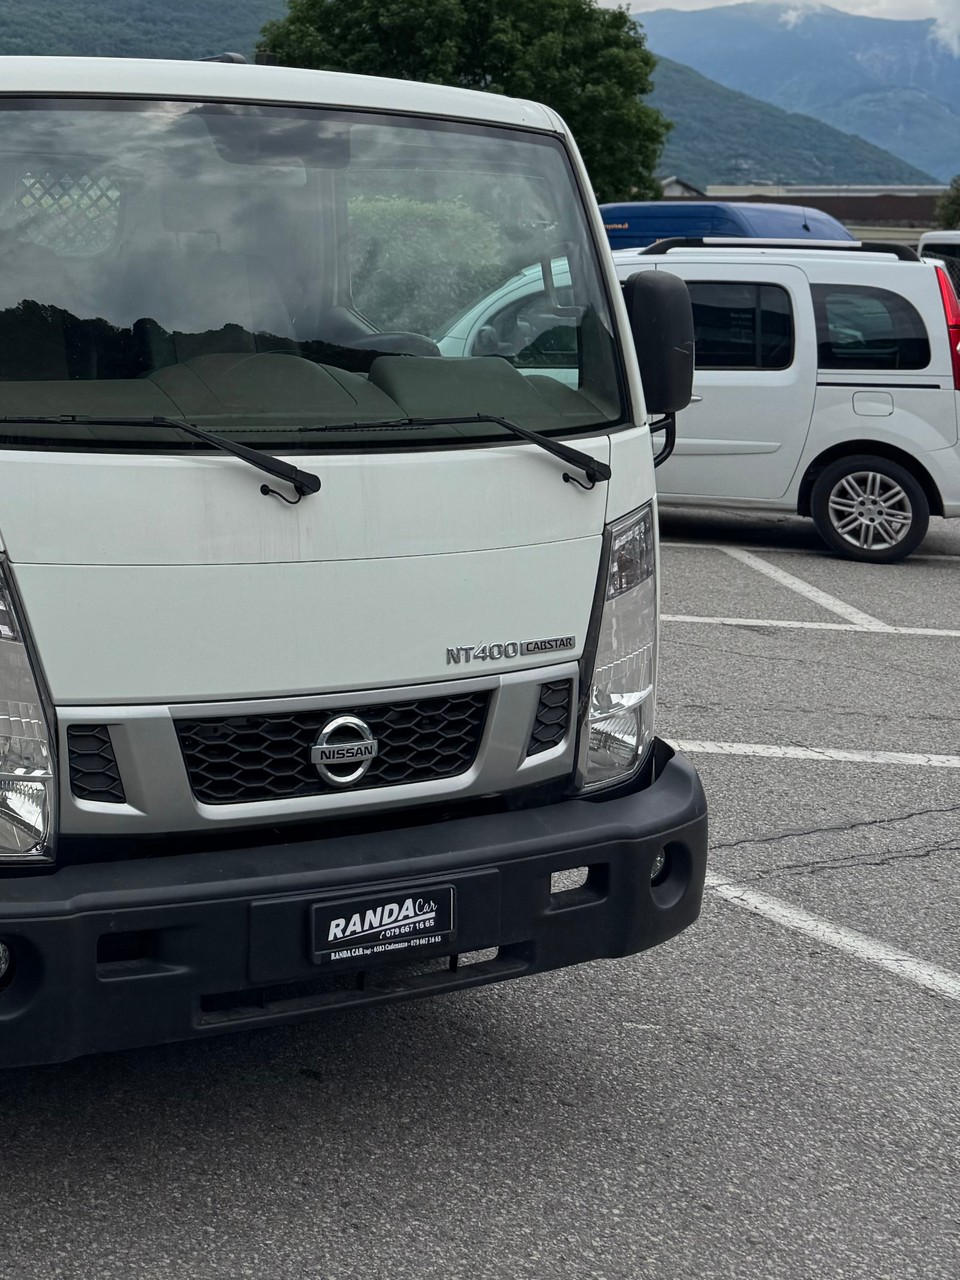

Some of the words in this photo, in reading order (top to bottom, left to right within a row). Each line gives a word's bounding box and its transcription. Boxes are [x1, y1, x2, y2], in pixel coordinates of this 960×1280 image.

[446, 641, 519, 665] NT400
[526, 638, 572, 652] CABSTAR
[320, 745, 373, 760] NISSAN
[328, 898, 415, 941] RANDA
[415, 898, 438, 915] Car
[385, 927, 400, 937] 079
[400, 924, 414, 933] 667
[415, 921, 424, 930] 16
[425, 919, 435, 928] 65
[330, 950, 351, 960] RANDA
[351, 947, 364, 956] CAR
